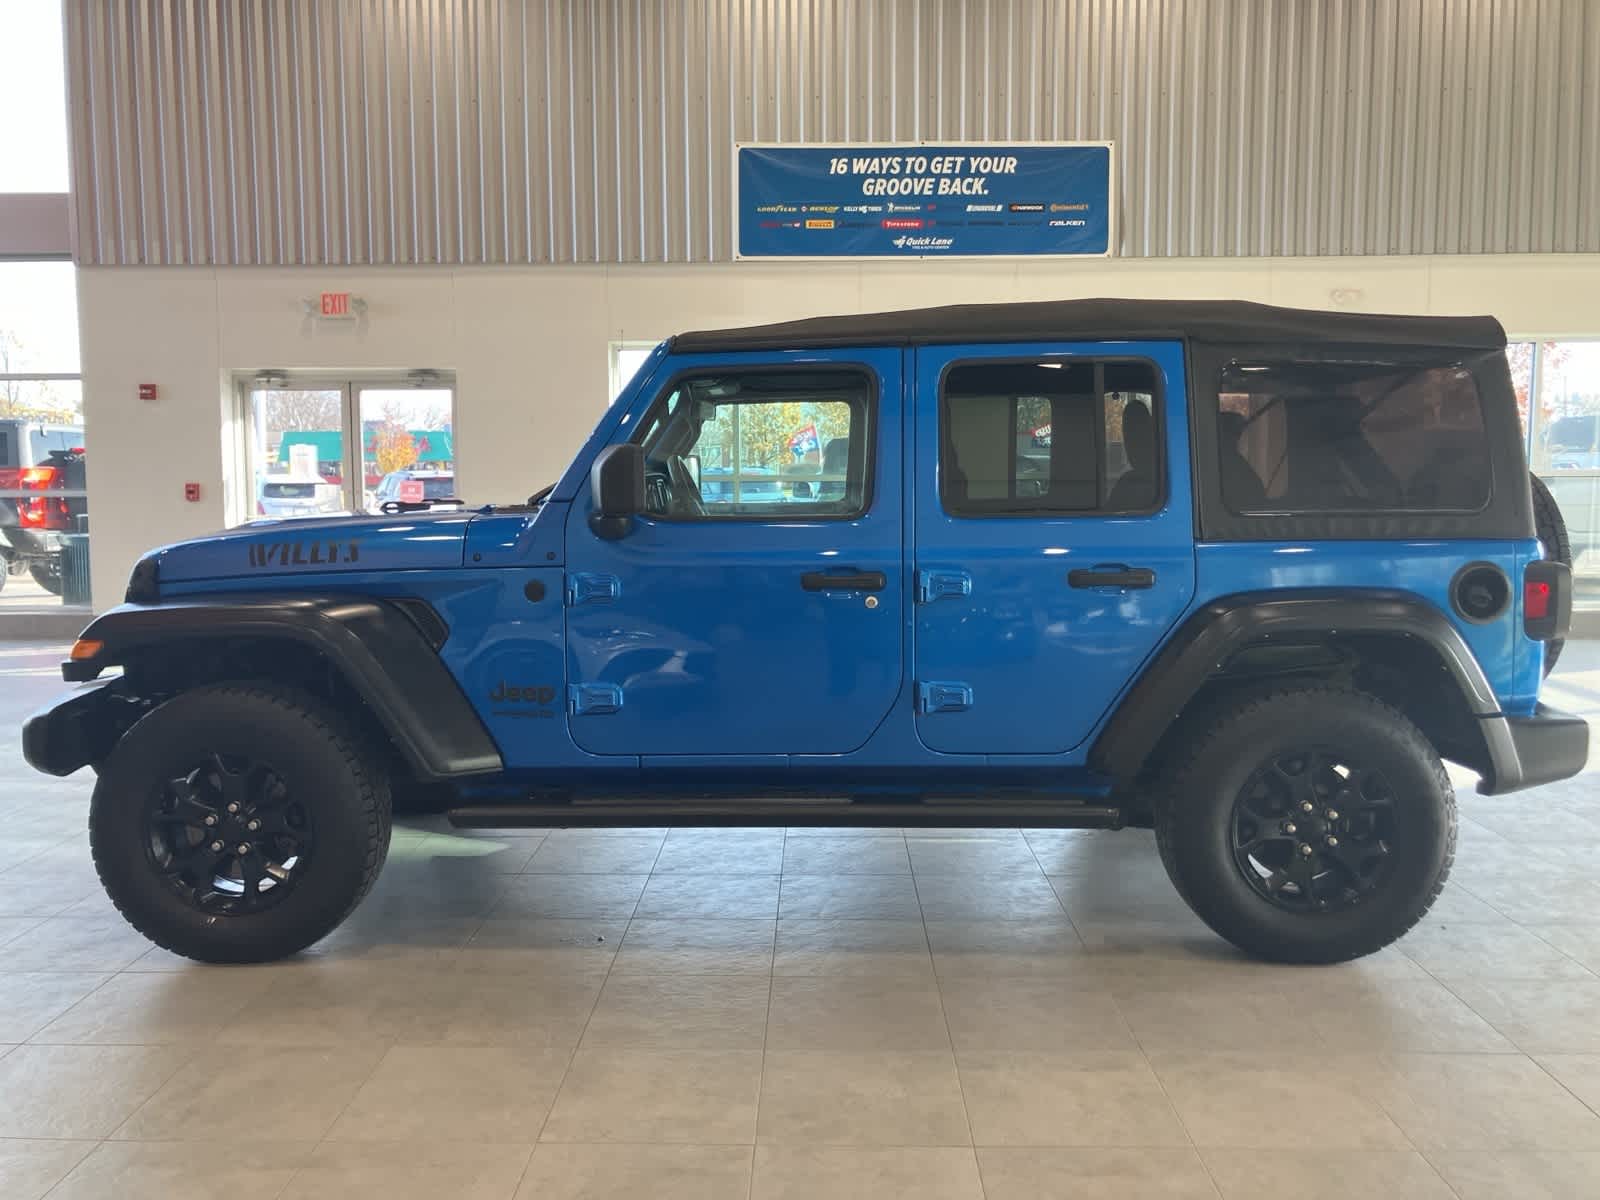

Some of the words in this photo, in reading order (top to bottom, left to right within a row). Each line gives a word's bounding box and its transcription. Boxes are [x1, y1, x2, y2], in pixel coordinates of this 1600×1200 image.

[830, 158, 848, 174] 16
[852, 157, 901, 174] WAYS
[905, 157, 927, 174] TO
[930, 157, 965, 174] GET
[969, 157, 1017, 174] YOUR
[862, 178, 935, 195] GROOVE
[938, 177, 989, 195] BACK.
[906, 236, 930, 246] Quick
[931, 236, 952, 246] Lane
[322, 294, 349, 314] EXIT
[248, 539, 361, 567] WILLYS
[490, 679, 556, 705] Jeep
